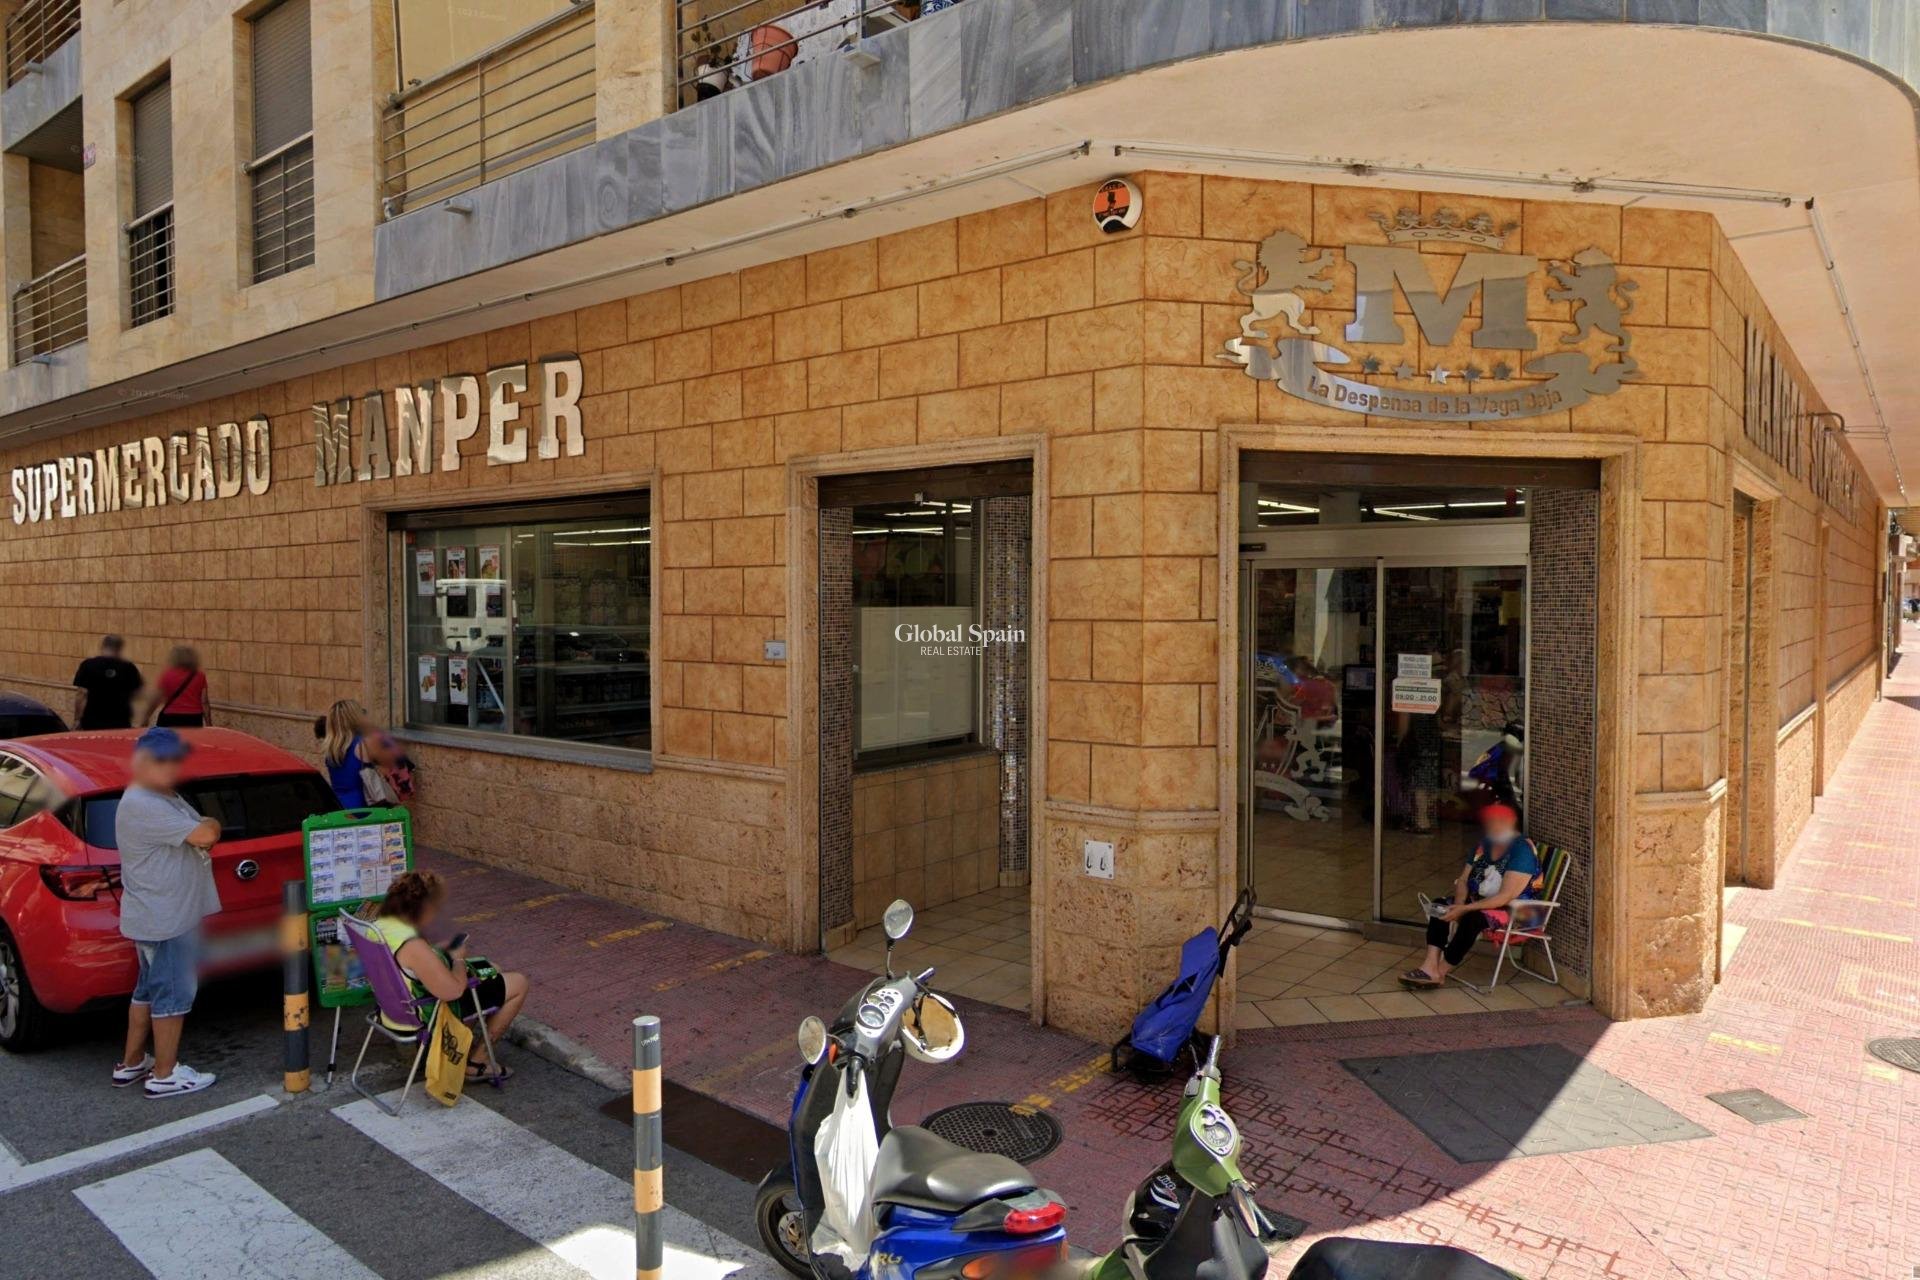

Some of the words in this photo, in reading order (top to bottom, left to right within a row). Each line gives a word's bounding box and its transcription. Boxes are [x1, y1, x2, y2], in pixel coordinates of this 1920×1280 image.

[1344, 244, 1539, 351] M
[11, 414, 271, 525] SUPERMERCADO
[312, 352, 584, 487] MANPER
[1307, 376, 1329, 398] La
[1335, 383, 1422, 412] Despensa
[1428, 397, 1449, 413] de
[1455, 397, 1470, 414] la
[1478, 396, 1520, 416] Vega
[1525, 388, 1563, 411] Baja
